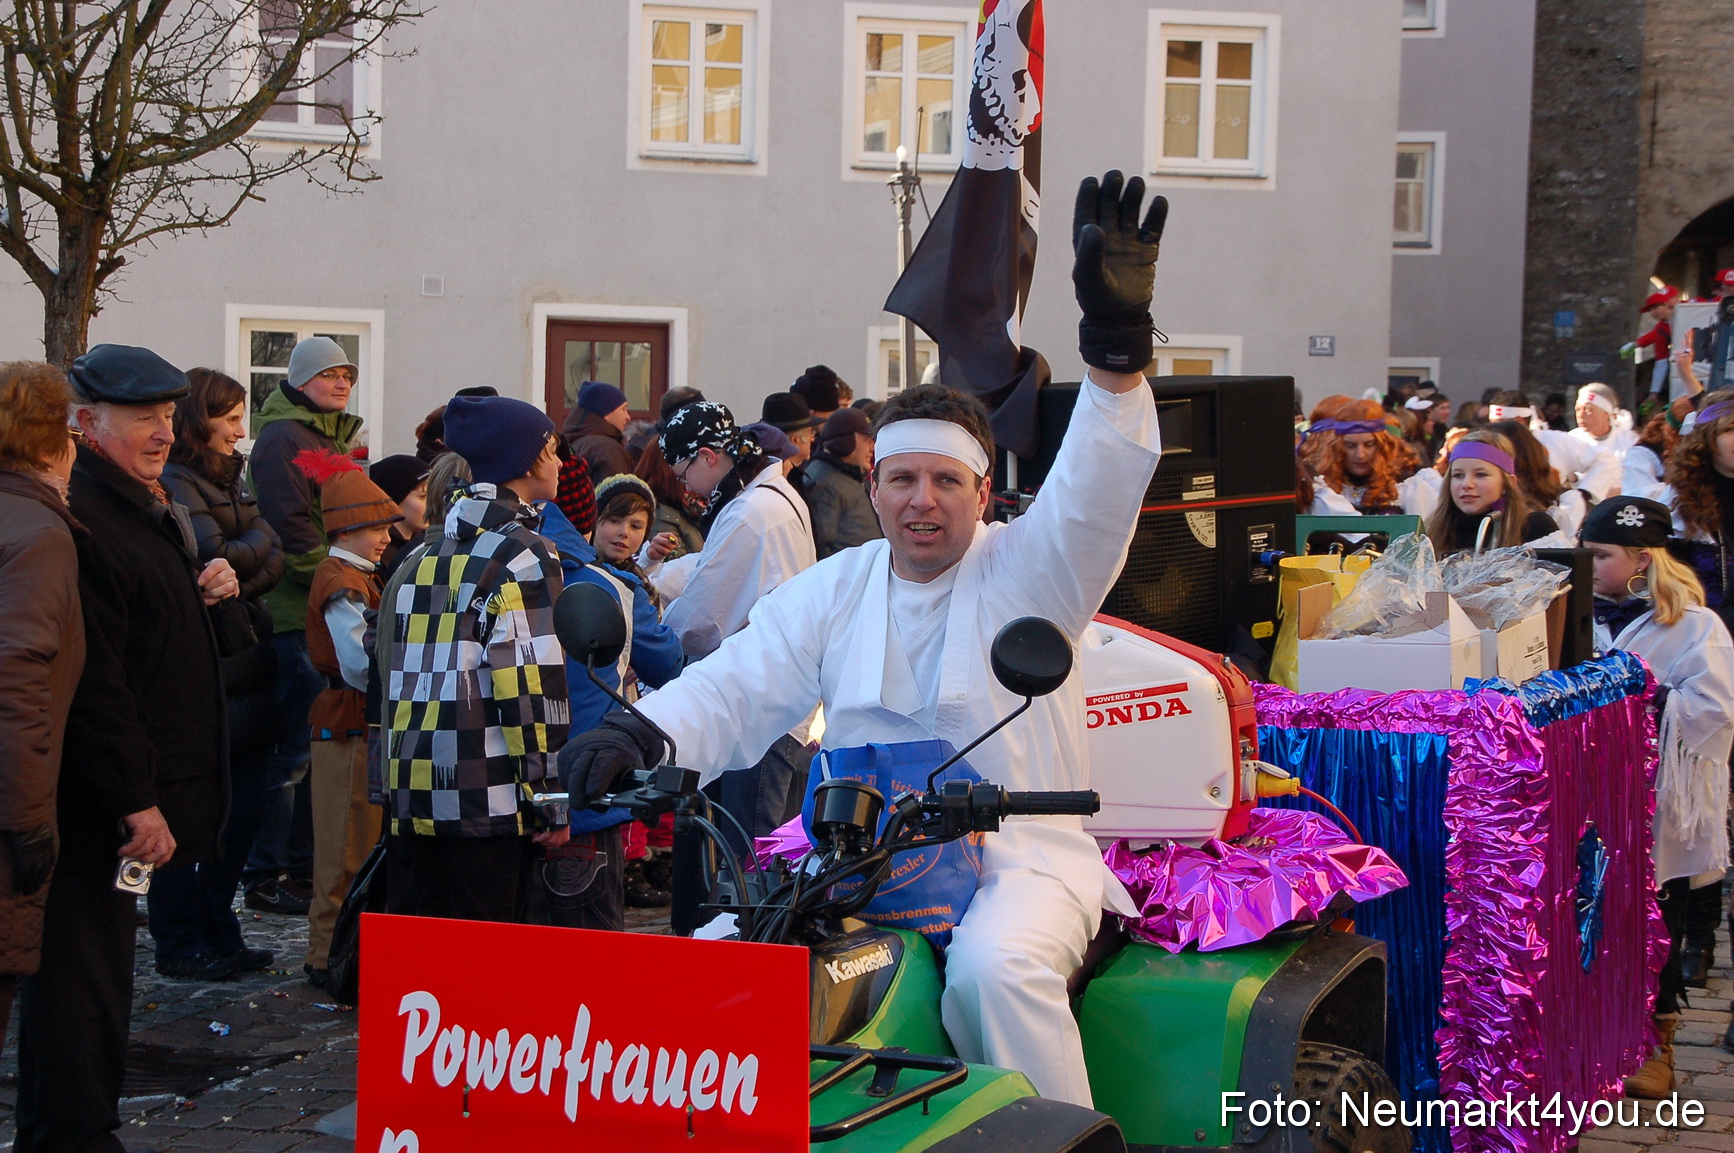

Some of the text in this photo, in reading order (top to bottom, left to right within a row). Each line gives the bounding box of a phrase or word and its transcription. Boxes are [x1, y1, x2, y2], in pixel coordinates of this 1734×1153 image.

[1315, 337, 1331, 349] 12
[1092, 690, 1144, 704] POWERED by
[1086, 697, 1192, 729] ONDA
[890, 852, 926, 880] rexler
[824, 943, 894, 984] Kawasaki
[398, 991, 759, 1123] Powerfrauen
